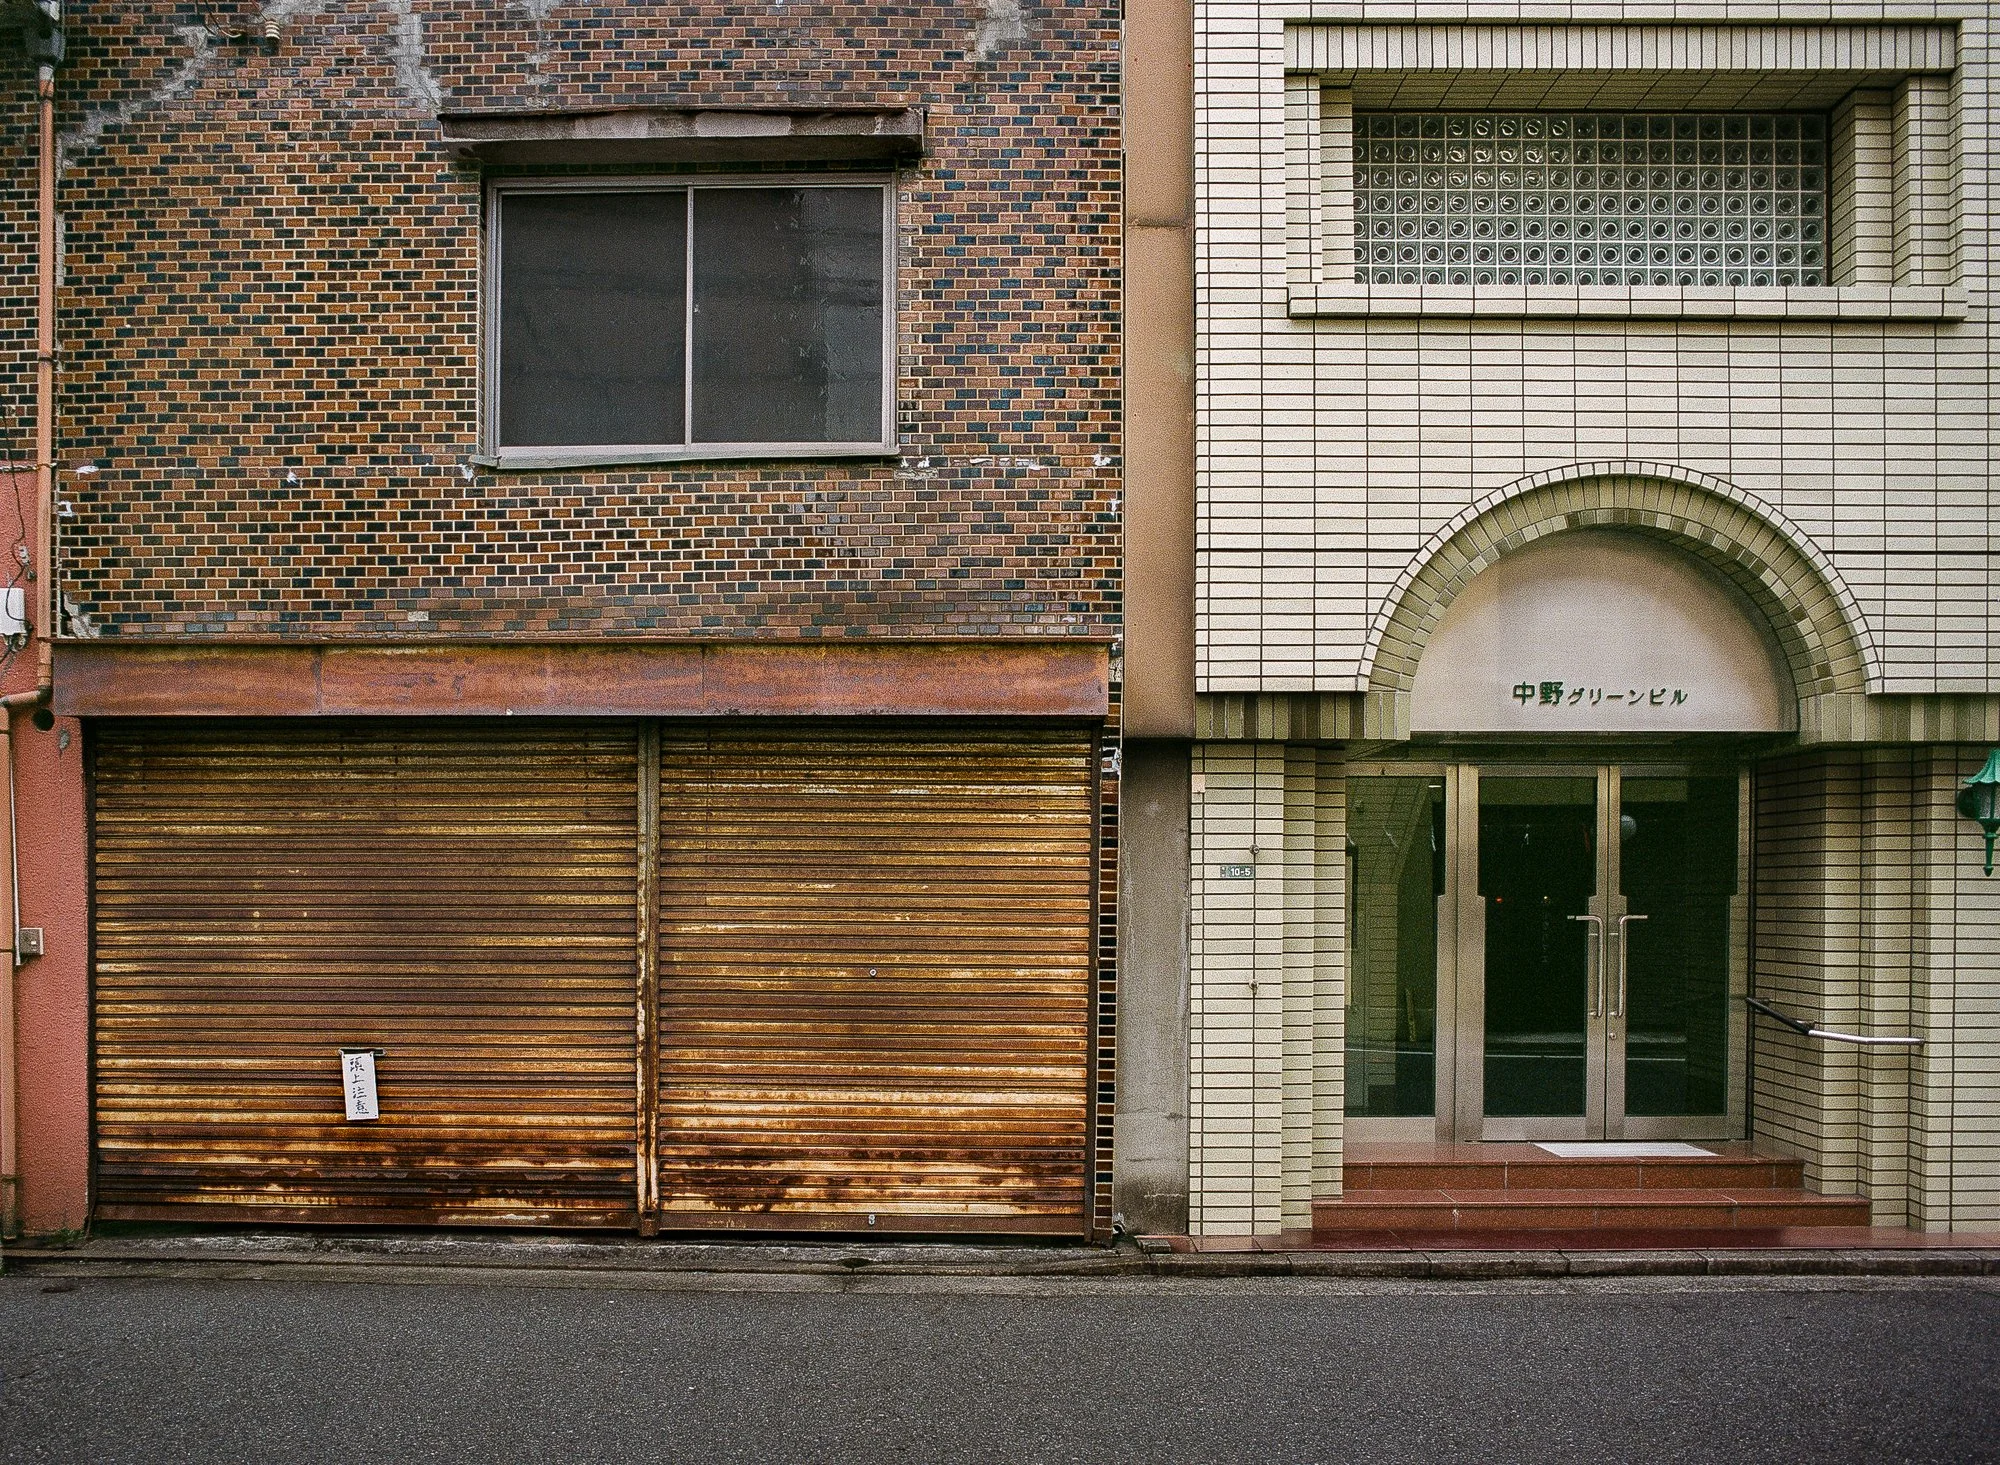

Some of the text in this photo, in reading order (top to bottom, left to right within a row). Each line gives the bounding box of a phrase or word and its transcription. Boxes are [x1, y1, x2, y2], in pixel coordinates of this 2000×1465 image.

[1513, 681, 1688, 706] 中野グリーンビル
[1230, 867, 1251, 877] 10-5
